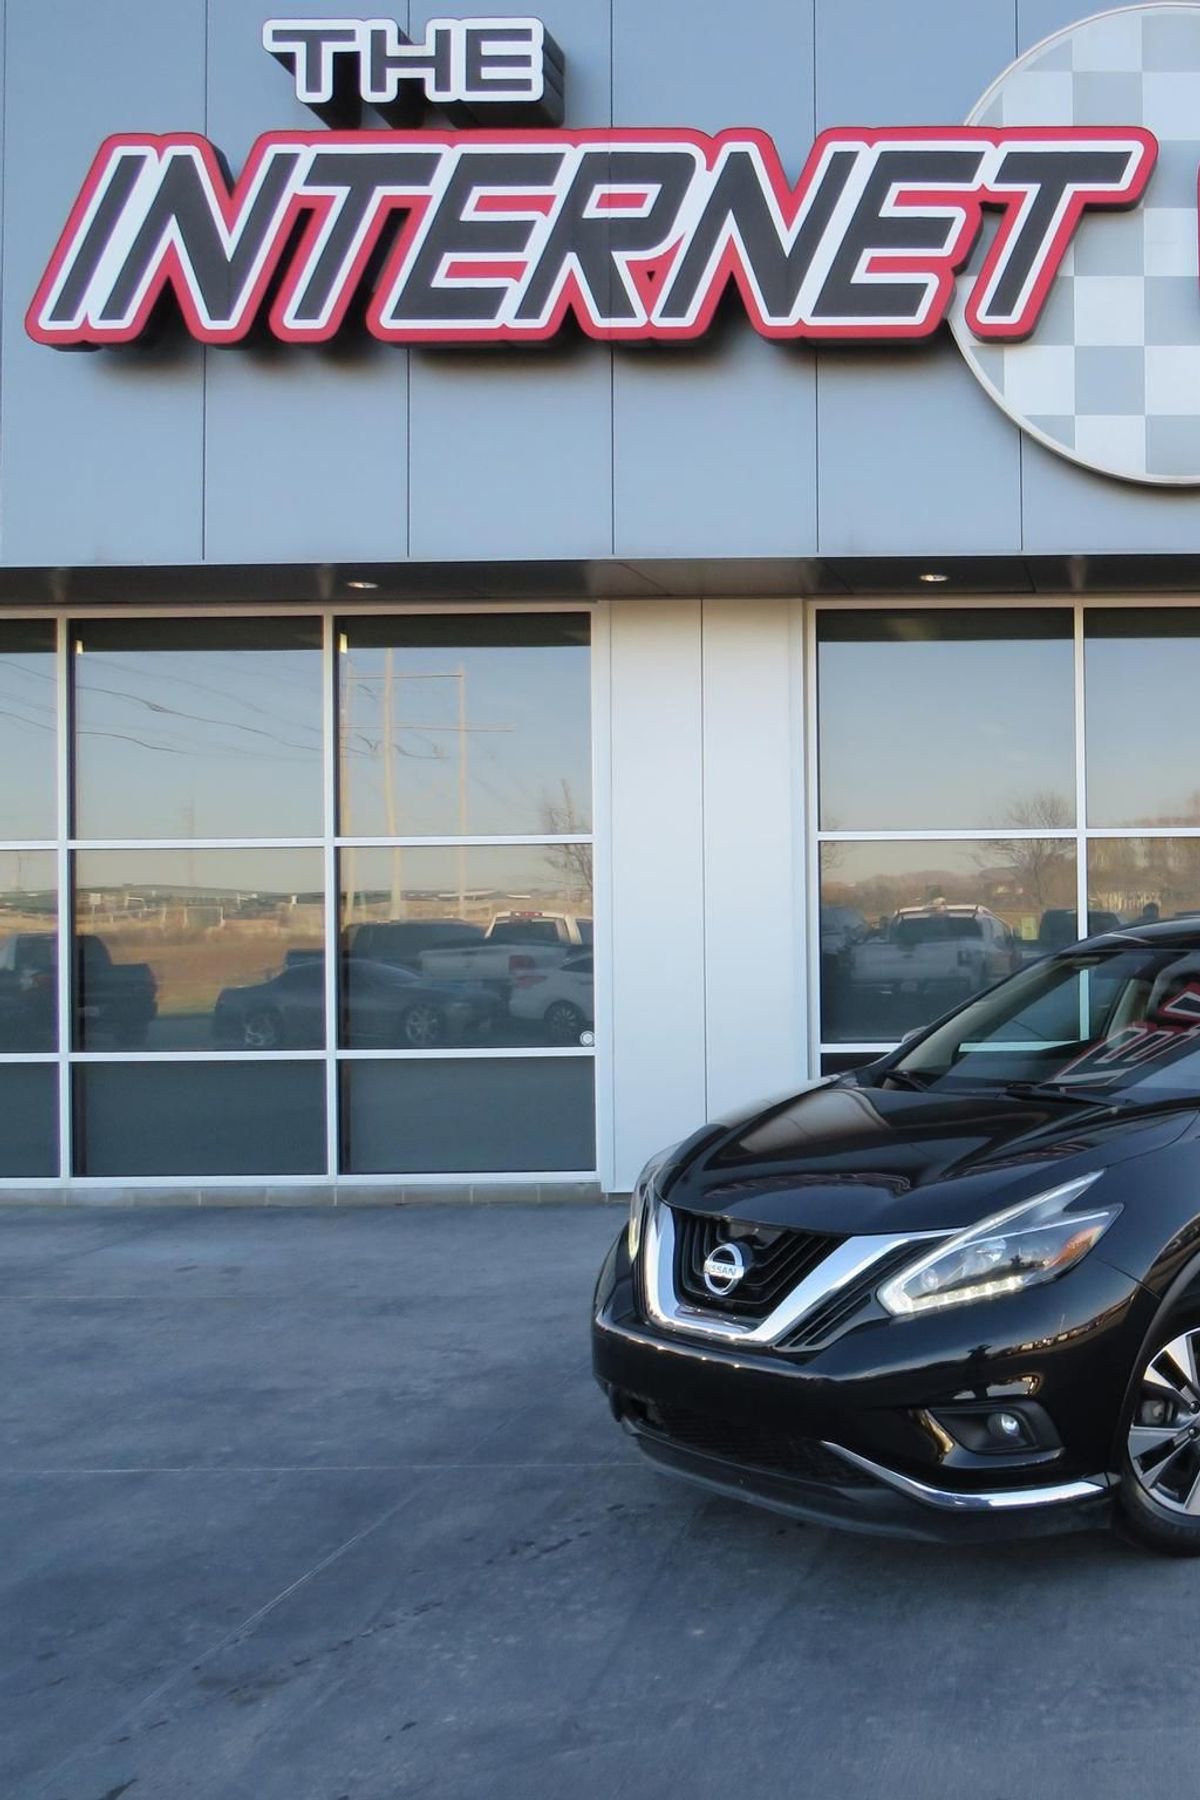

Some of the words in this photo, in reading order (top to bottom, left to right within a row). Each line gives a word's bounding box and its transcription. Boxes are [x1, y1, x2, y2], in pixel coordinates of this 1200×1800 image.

[263, 18, 544, 103] THE
[36, 137, 1152, 334] INTERNET
[705, 1261, 737, 1276] SSAN
